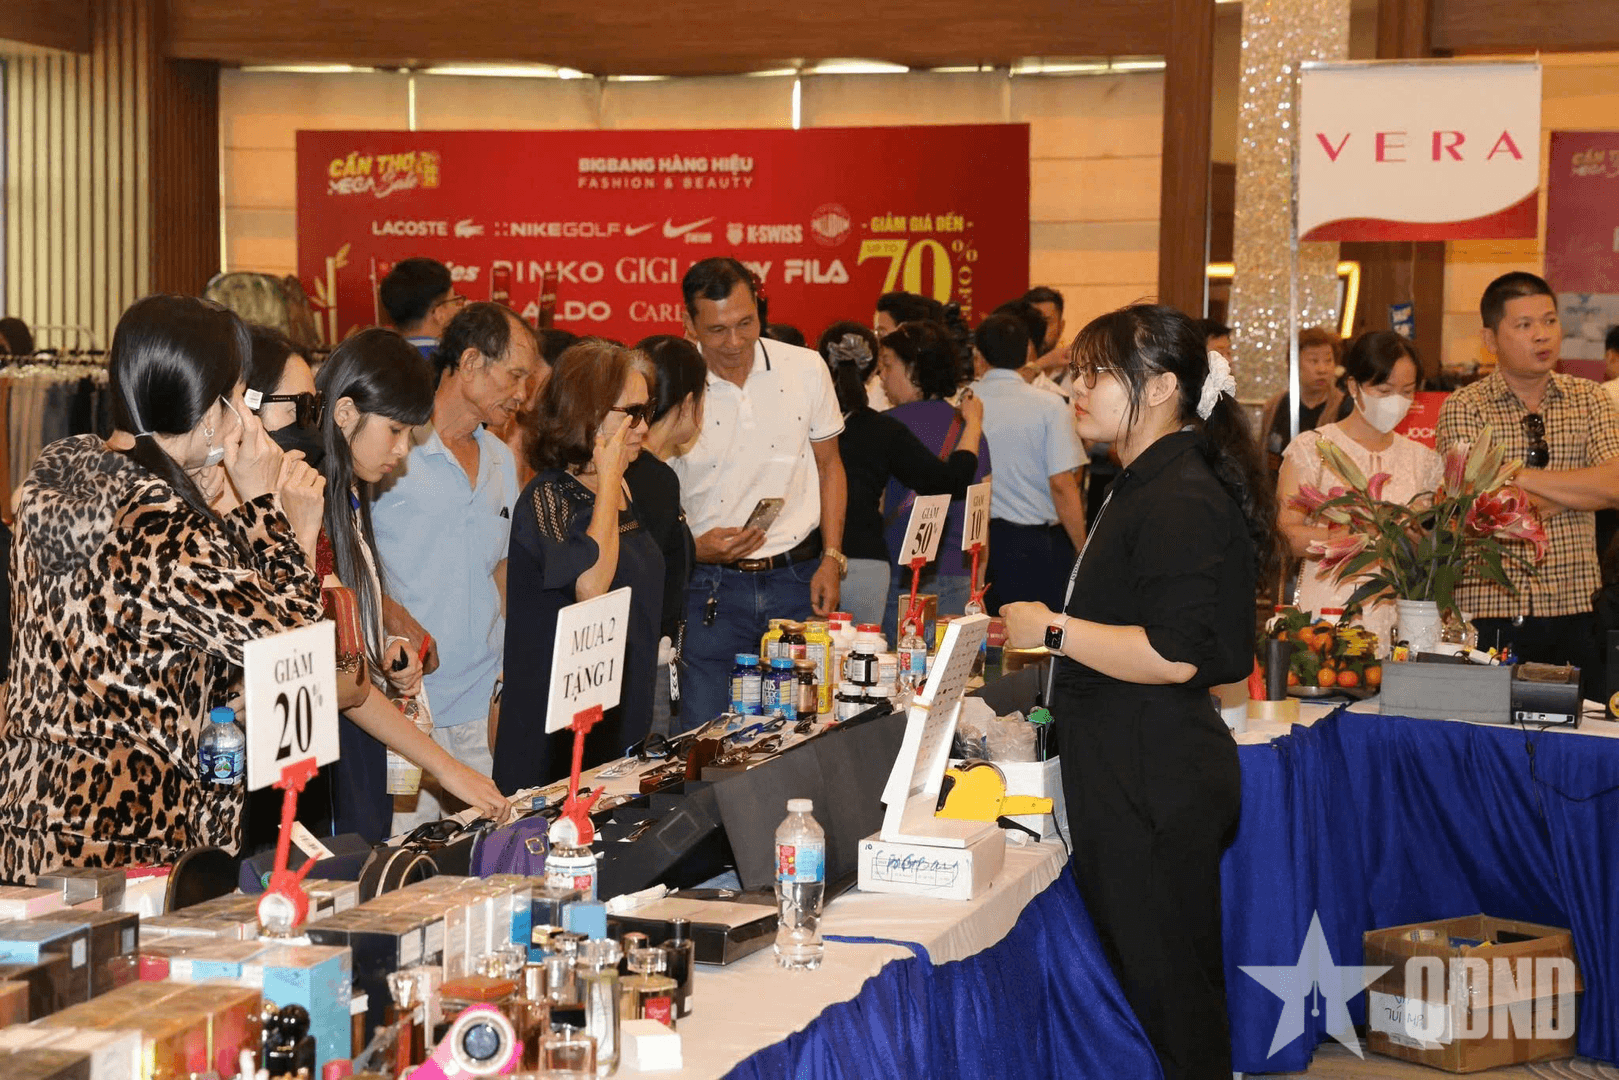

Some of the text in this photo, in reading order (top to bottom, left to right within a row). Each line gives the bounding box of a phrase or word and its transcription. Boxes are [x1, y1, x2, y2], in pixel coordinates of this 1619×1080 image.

[1315, 130, 1525, 162] VERA
[578, 157, 656, 173] BIGBANG
[658, 153, 708, 173] HÀNG
[577, 177, 754, 189] FASHION & BEAUTY
[371, 220, 449, 236] LACOSTE
[746, 223, 803, 244] K-SWISS
[870, 211, 907, 233] GIẢM
[909, 212, 934, 233] GIÁ
[615, 256, 679, 284] GIGI
[784, 259, 850, 284] FILA
[570, 616, 616, 656] MUA 2
[274, 648, 314, 685] GIẢM
[563, 657, 615, 702] TẶNG 1
